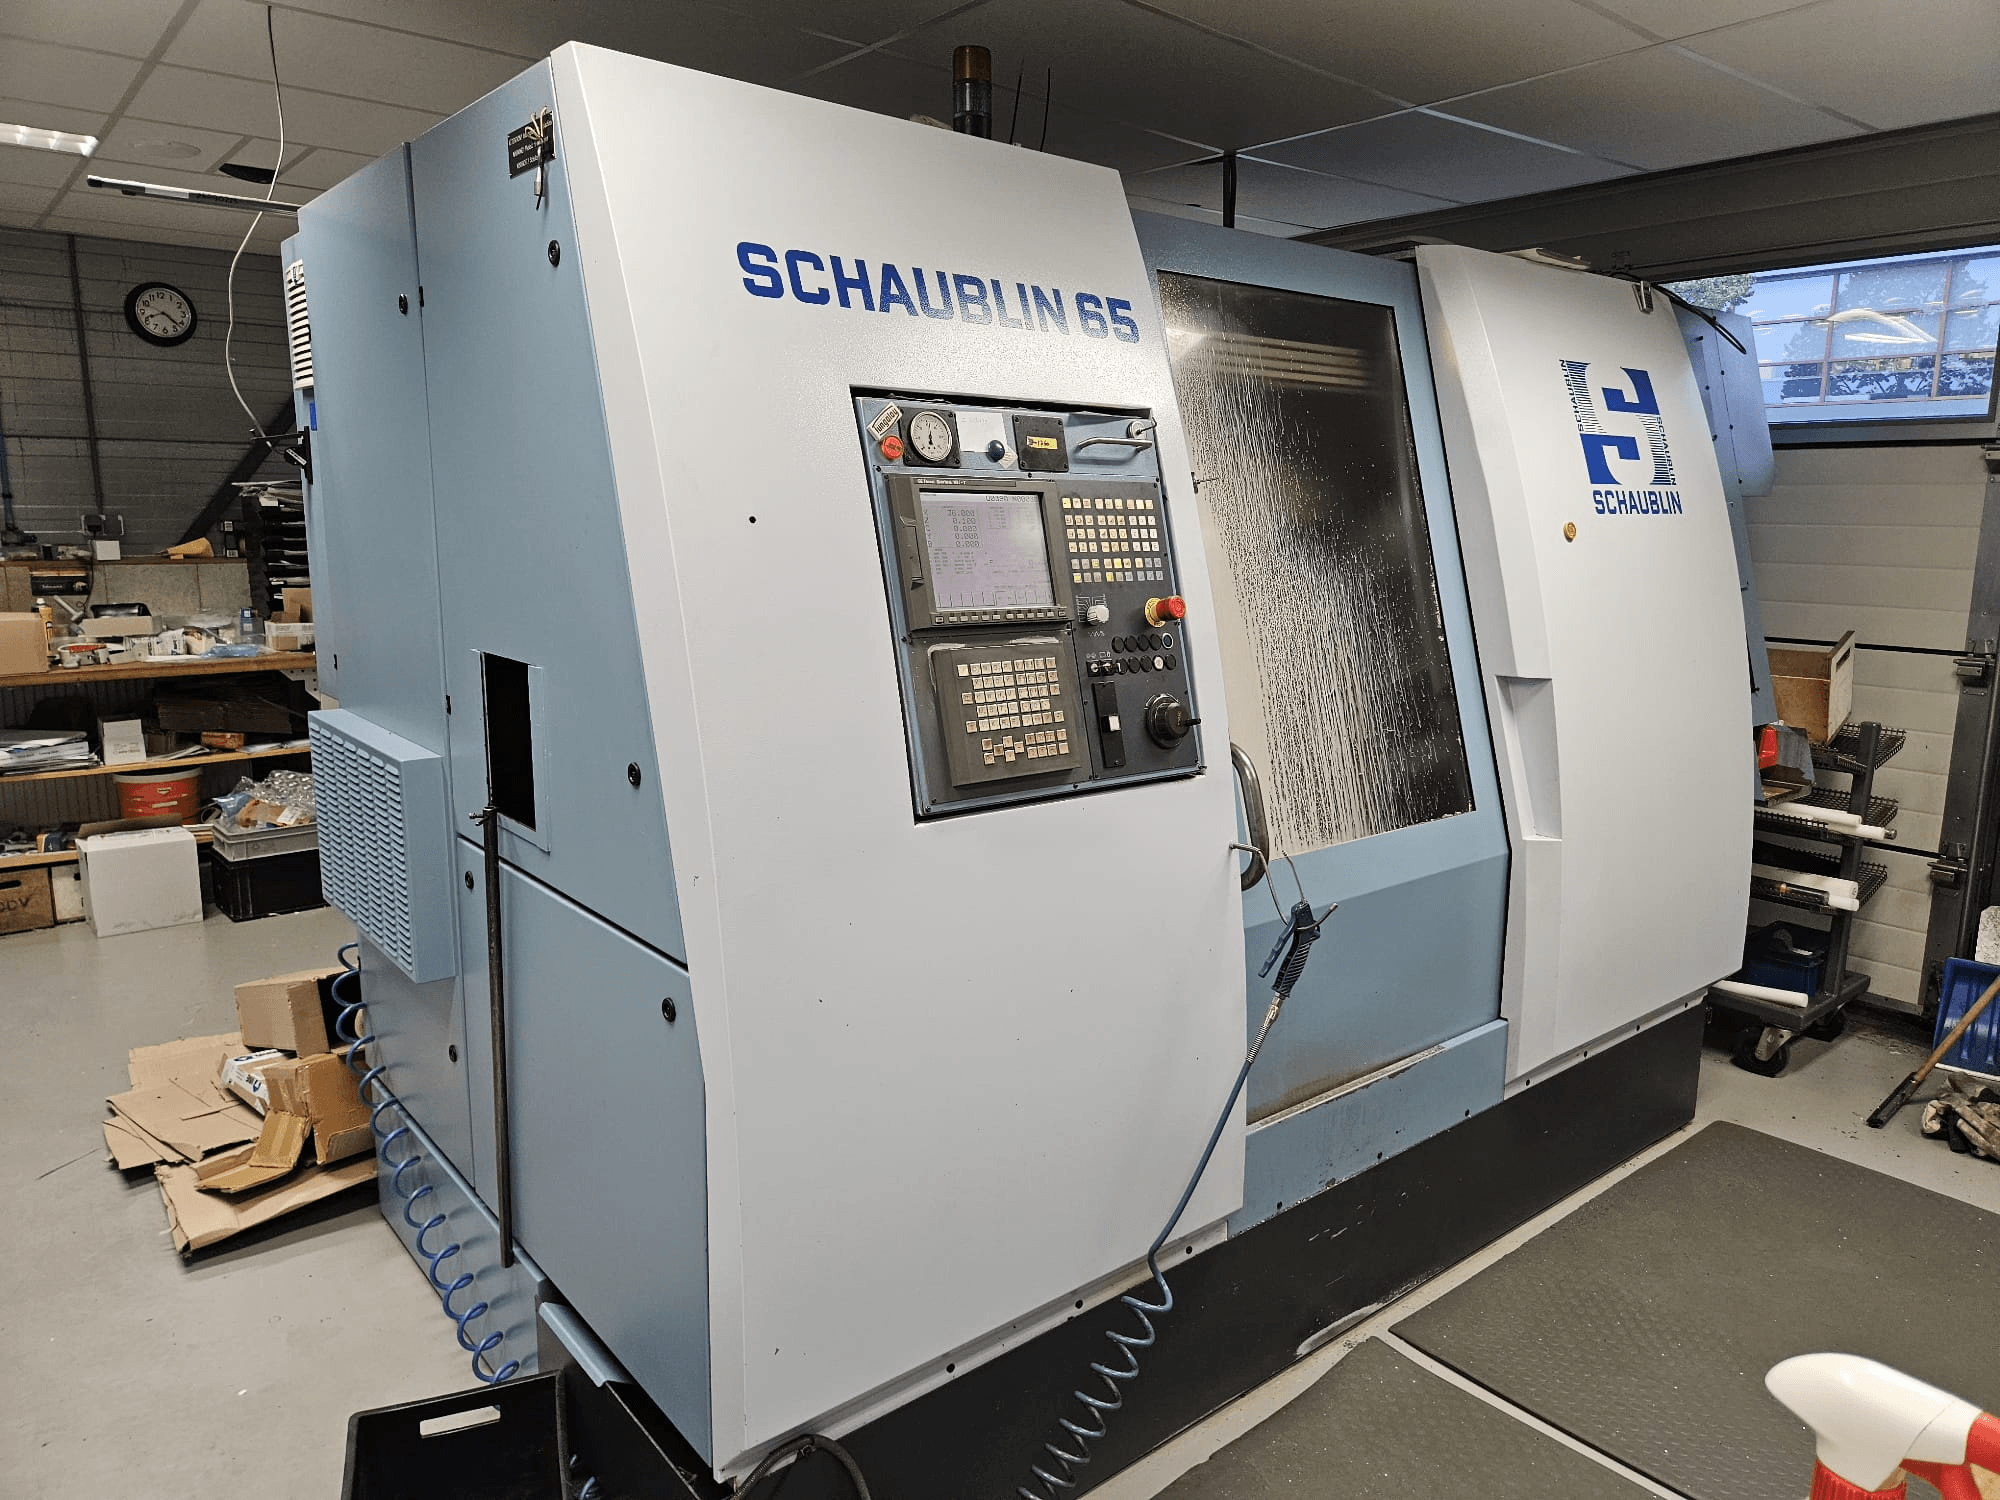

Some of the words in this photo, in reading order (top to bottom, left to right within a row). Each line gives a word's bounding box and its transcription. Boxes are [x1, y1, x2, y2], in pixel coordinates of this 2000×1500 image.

[142, 299, 150, 307] 10
[156, 291, 164, 299] 12
[736, 241, 1070, 335] SCHAUBLIN
[1075, 292, 1140, 344] 65
[1559, 359, 1584, 432] SCHAUBLIN
[1656, 416, 1677, 486] SCHAUBLIN
[1592, 489, 1683, 515] SCHAUBLIN
